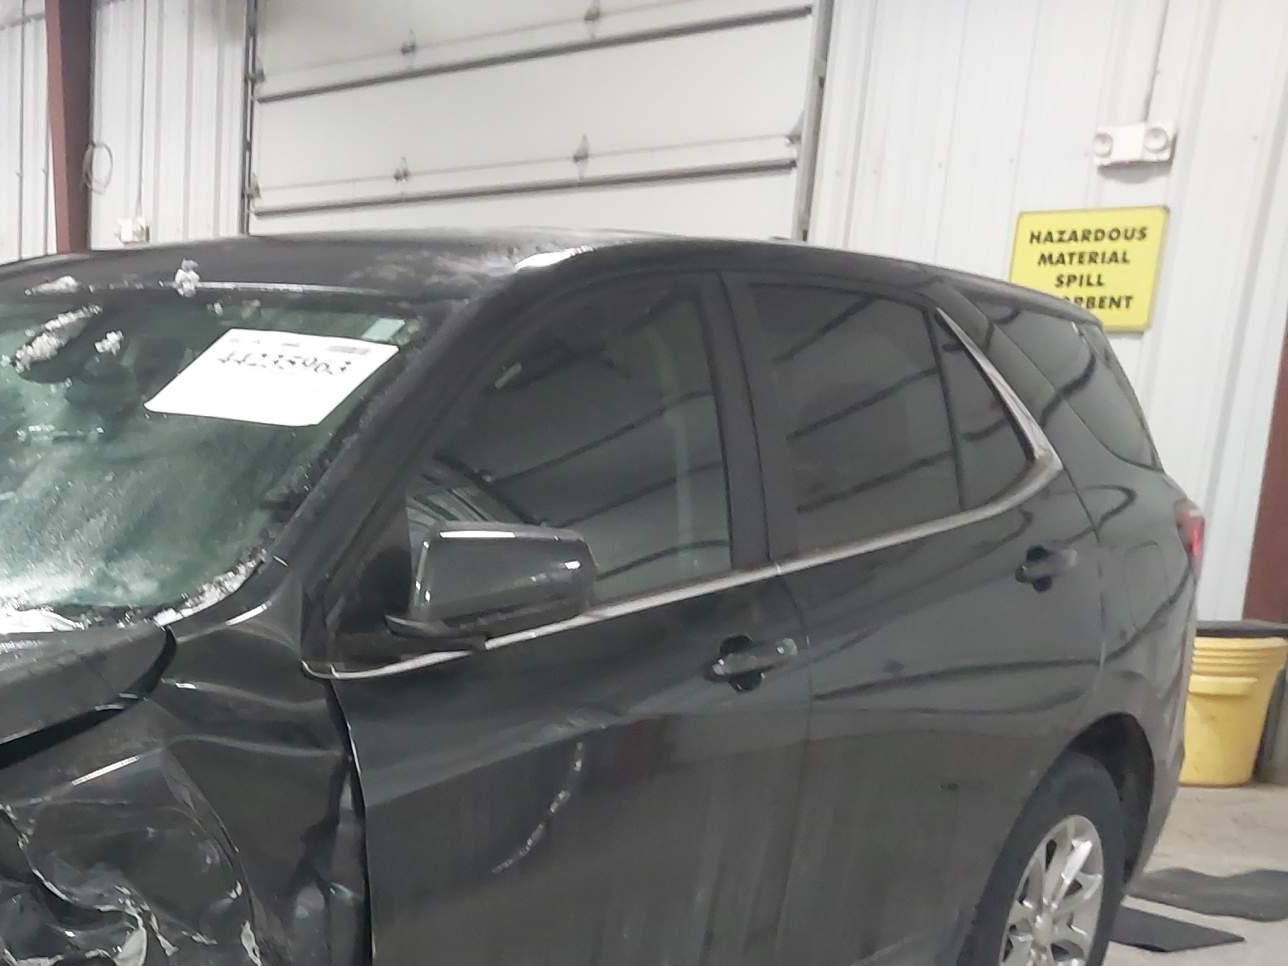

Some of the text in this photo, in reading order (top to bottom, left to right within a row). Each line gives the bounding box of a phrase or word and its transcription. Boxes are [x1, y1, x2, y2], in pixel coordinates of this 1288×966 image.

[1028, 225, 1149, 245] HAZARDOUS
[1037, 250, 1131, 267] MATERIAL
[1054, 273, 1105, 289] SPILL
